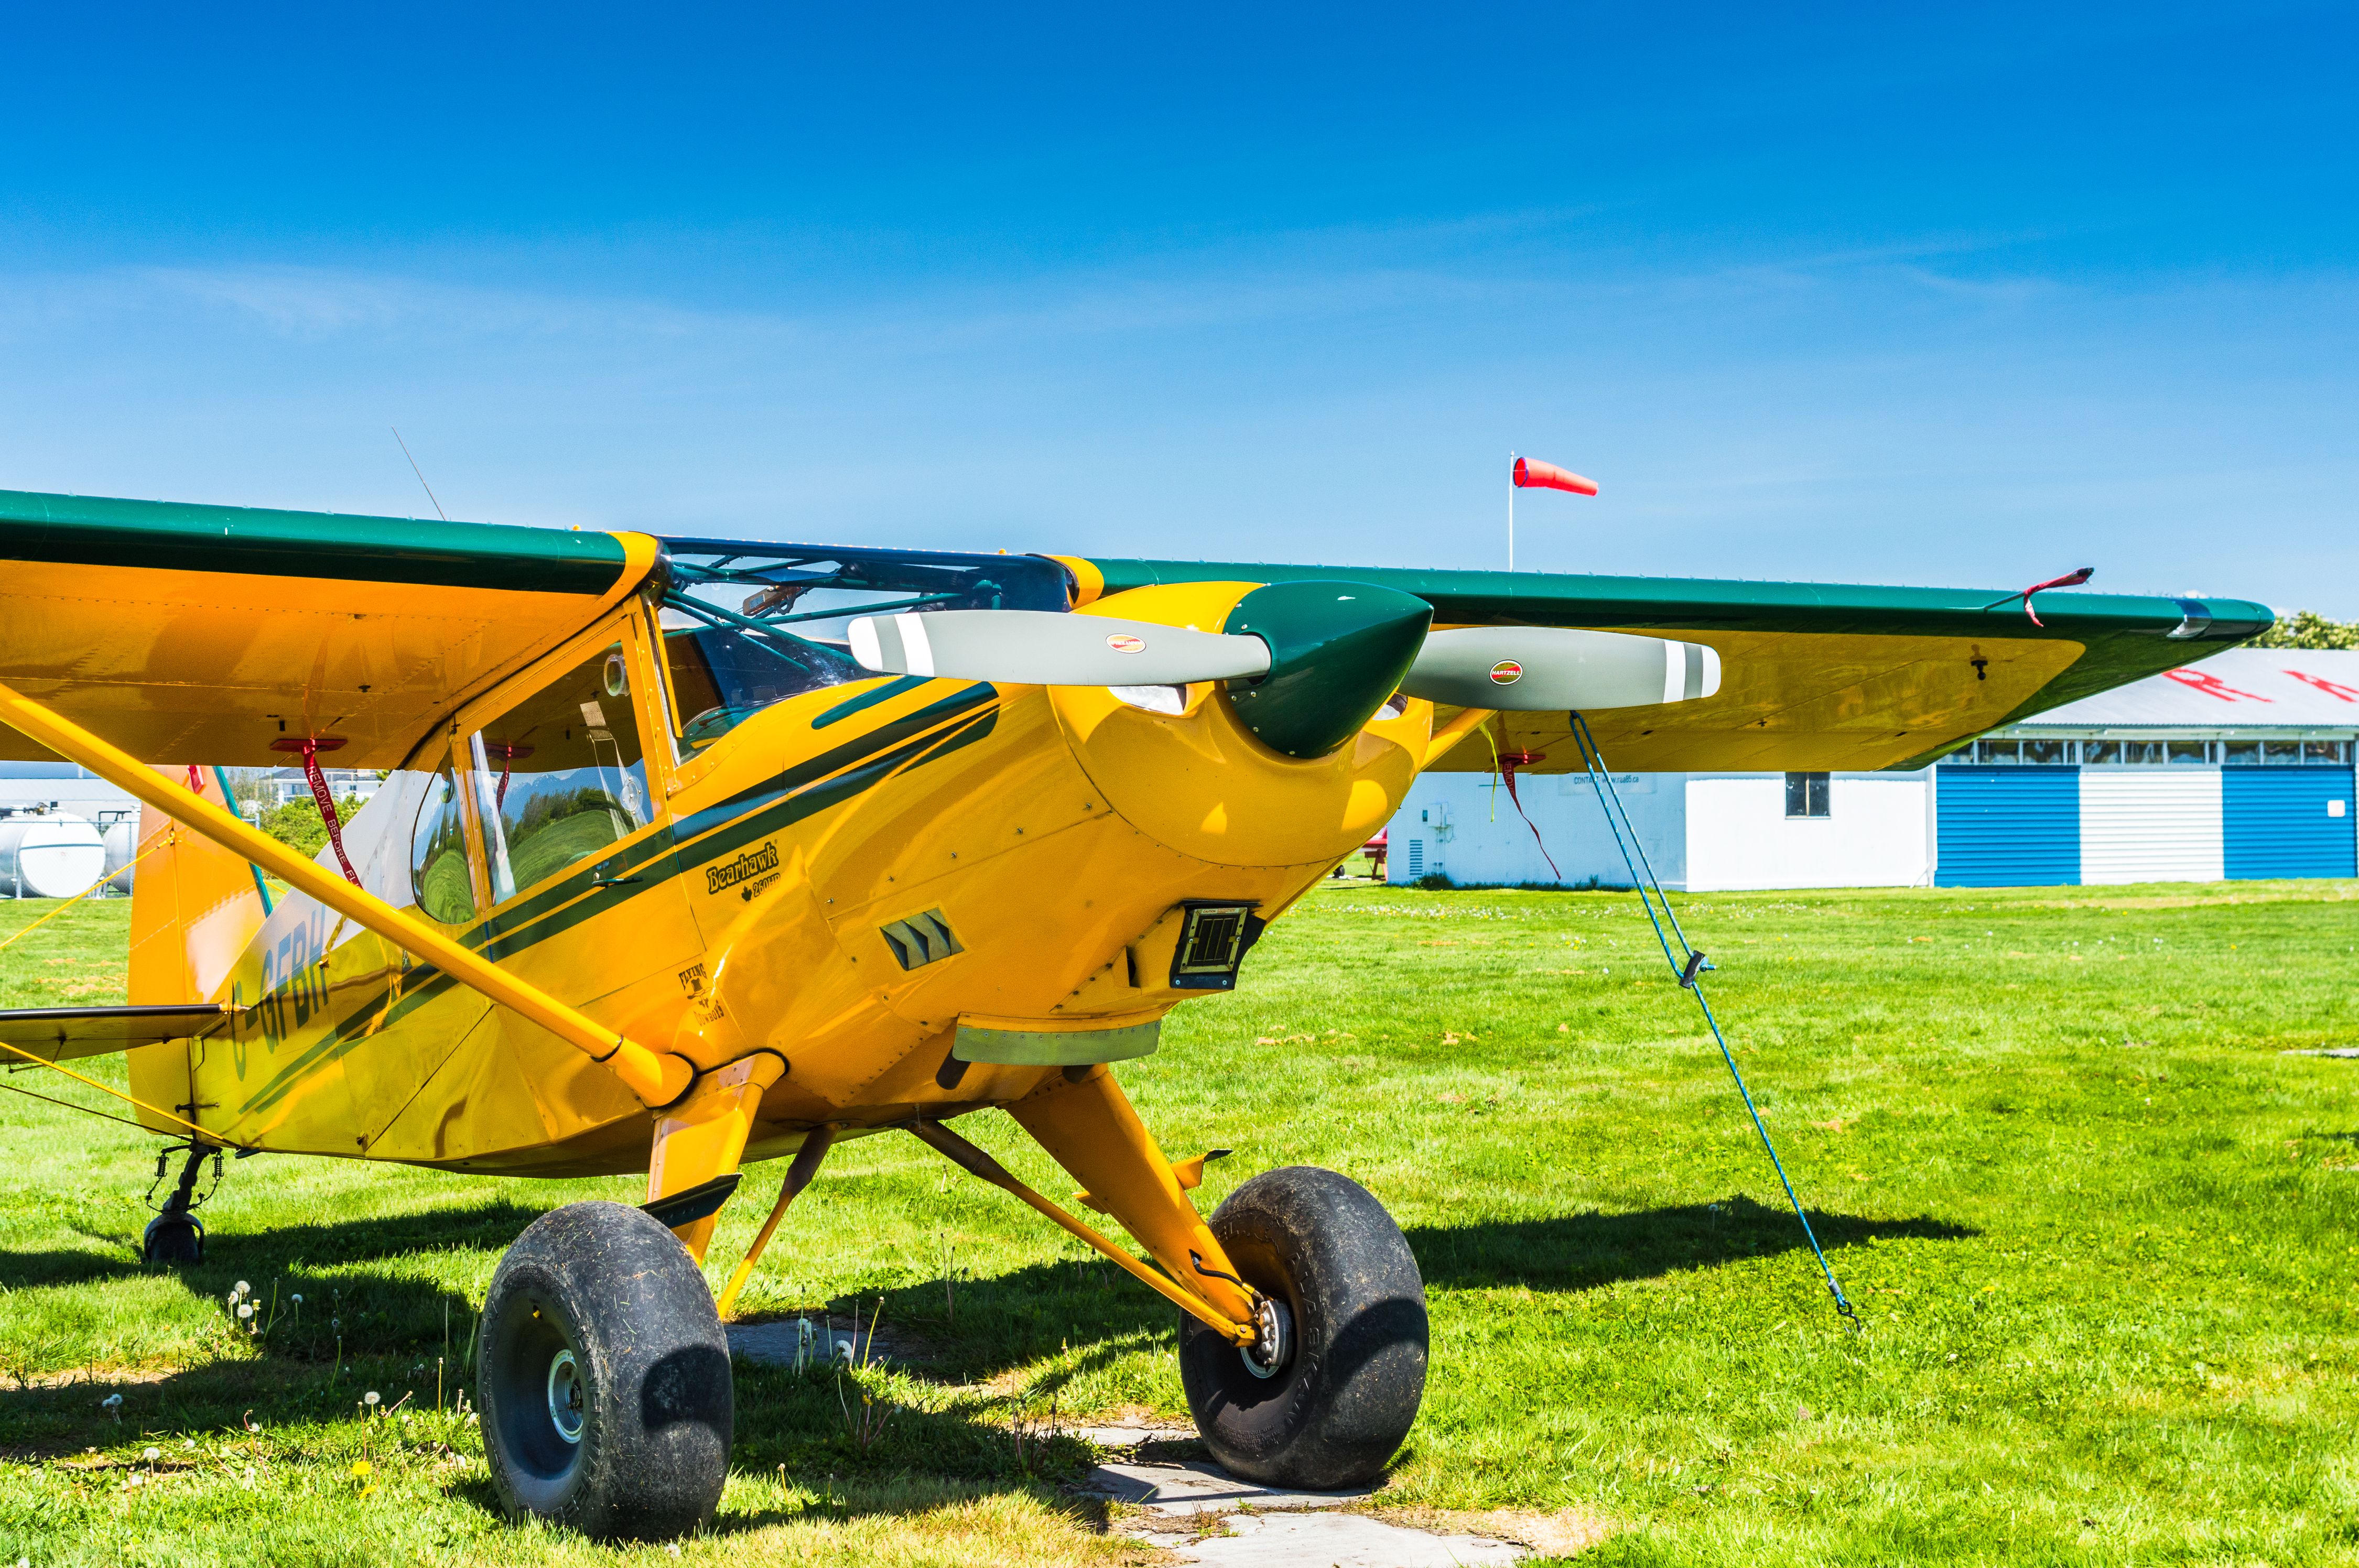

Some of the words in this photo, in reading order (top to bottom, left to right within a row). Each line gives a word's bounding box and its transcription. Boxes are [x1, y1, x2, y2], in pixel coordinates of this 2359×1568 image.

[1574, 776, 1599, 785] CONTAT
[1601, 775, 1639, 784] ww.raa85.ca
[306, 766, 332, 813] REMOVE
[328, 819, 347, 864] BEFORE
[706, 842, 779, 895] Bearhawk
[752, 873, 781, 898] 260HP
[678, 963, 707, 990] FLYING
[693, 999, 724, 1027] COWBOYS
